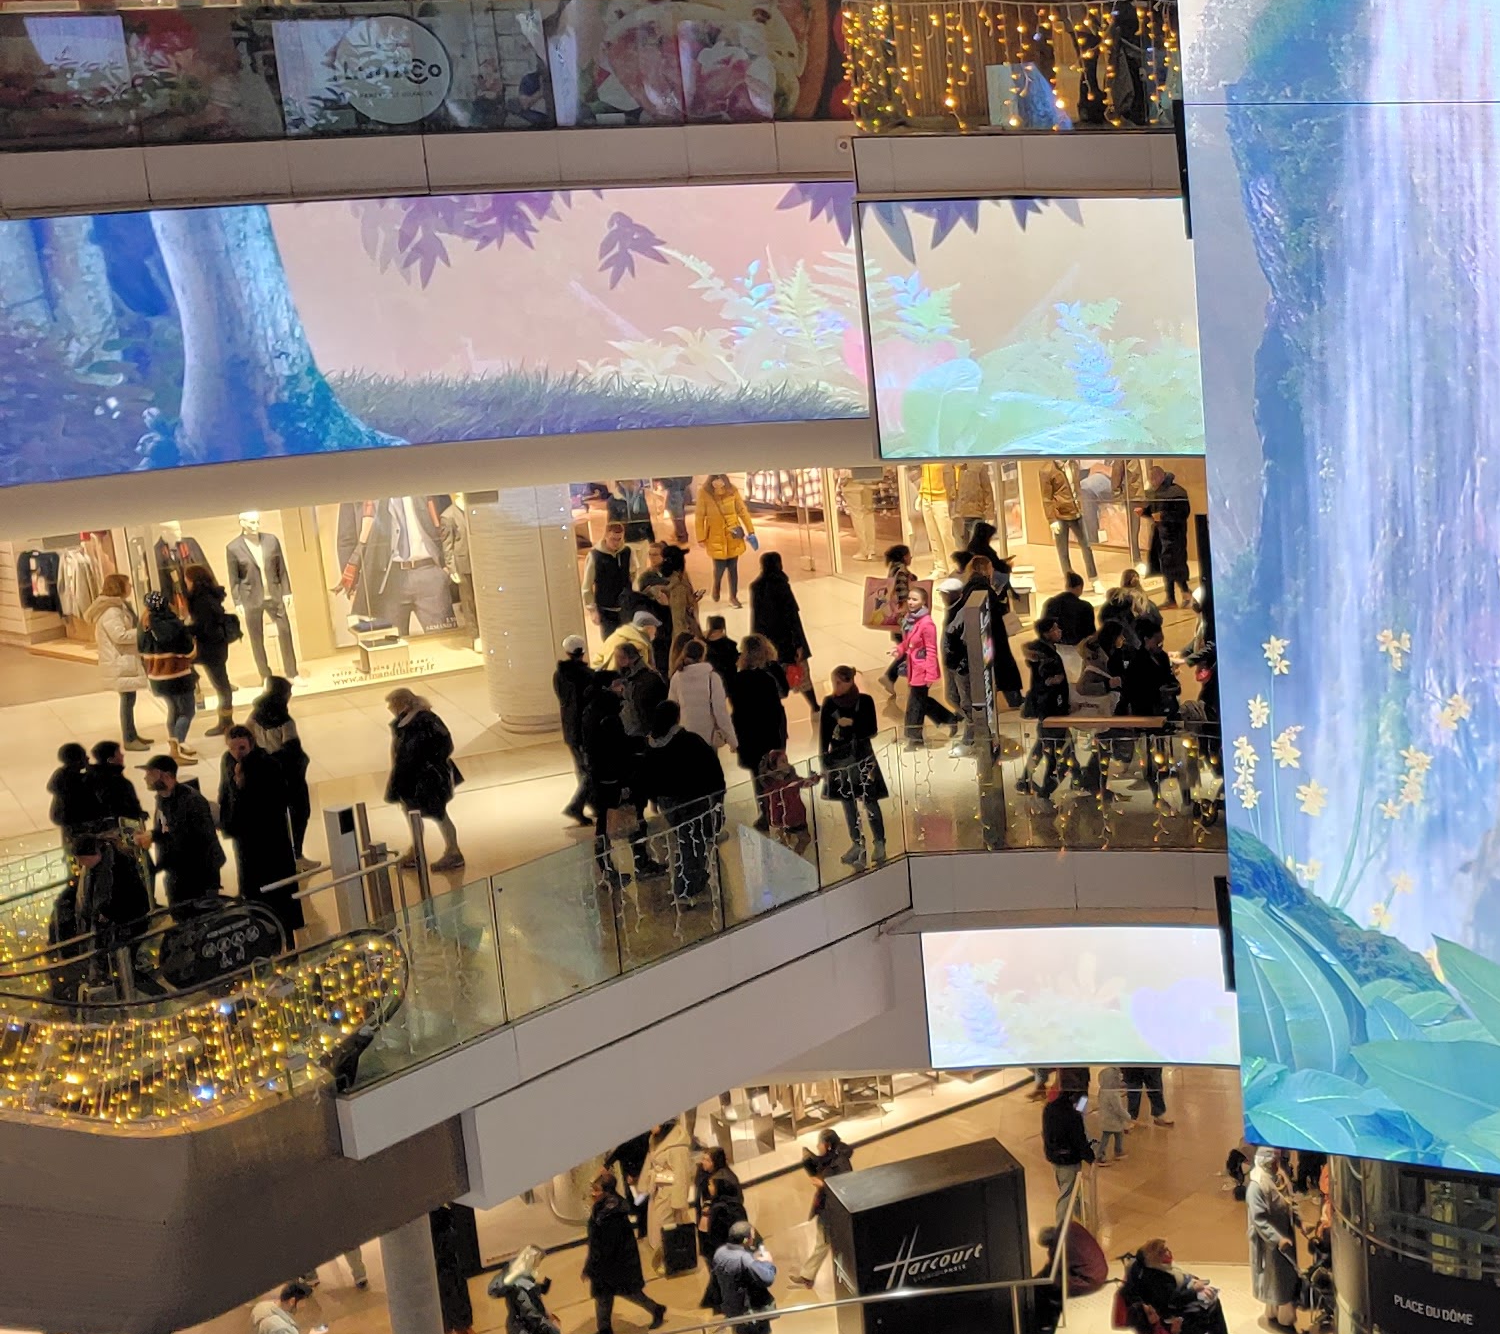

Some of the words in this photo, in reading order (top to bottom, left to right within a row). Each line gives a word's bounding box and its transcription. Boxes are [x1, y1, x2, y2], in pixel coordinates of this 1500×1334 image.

[873, 1225, 983, 1290] Harcourt
[1393, 1294, 1425, 1315] PLACE
[1425, 1305, 1440, 1318] DU
[1442, 1308, 1474, 1325] DÔME
